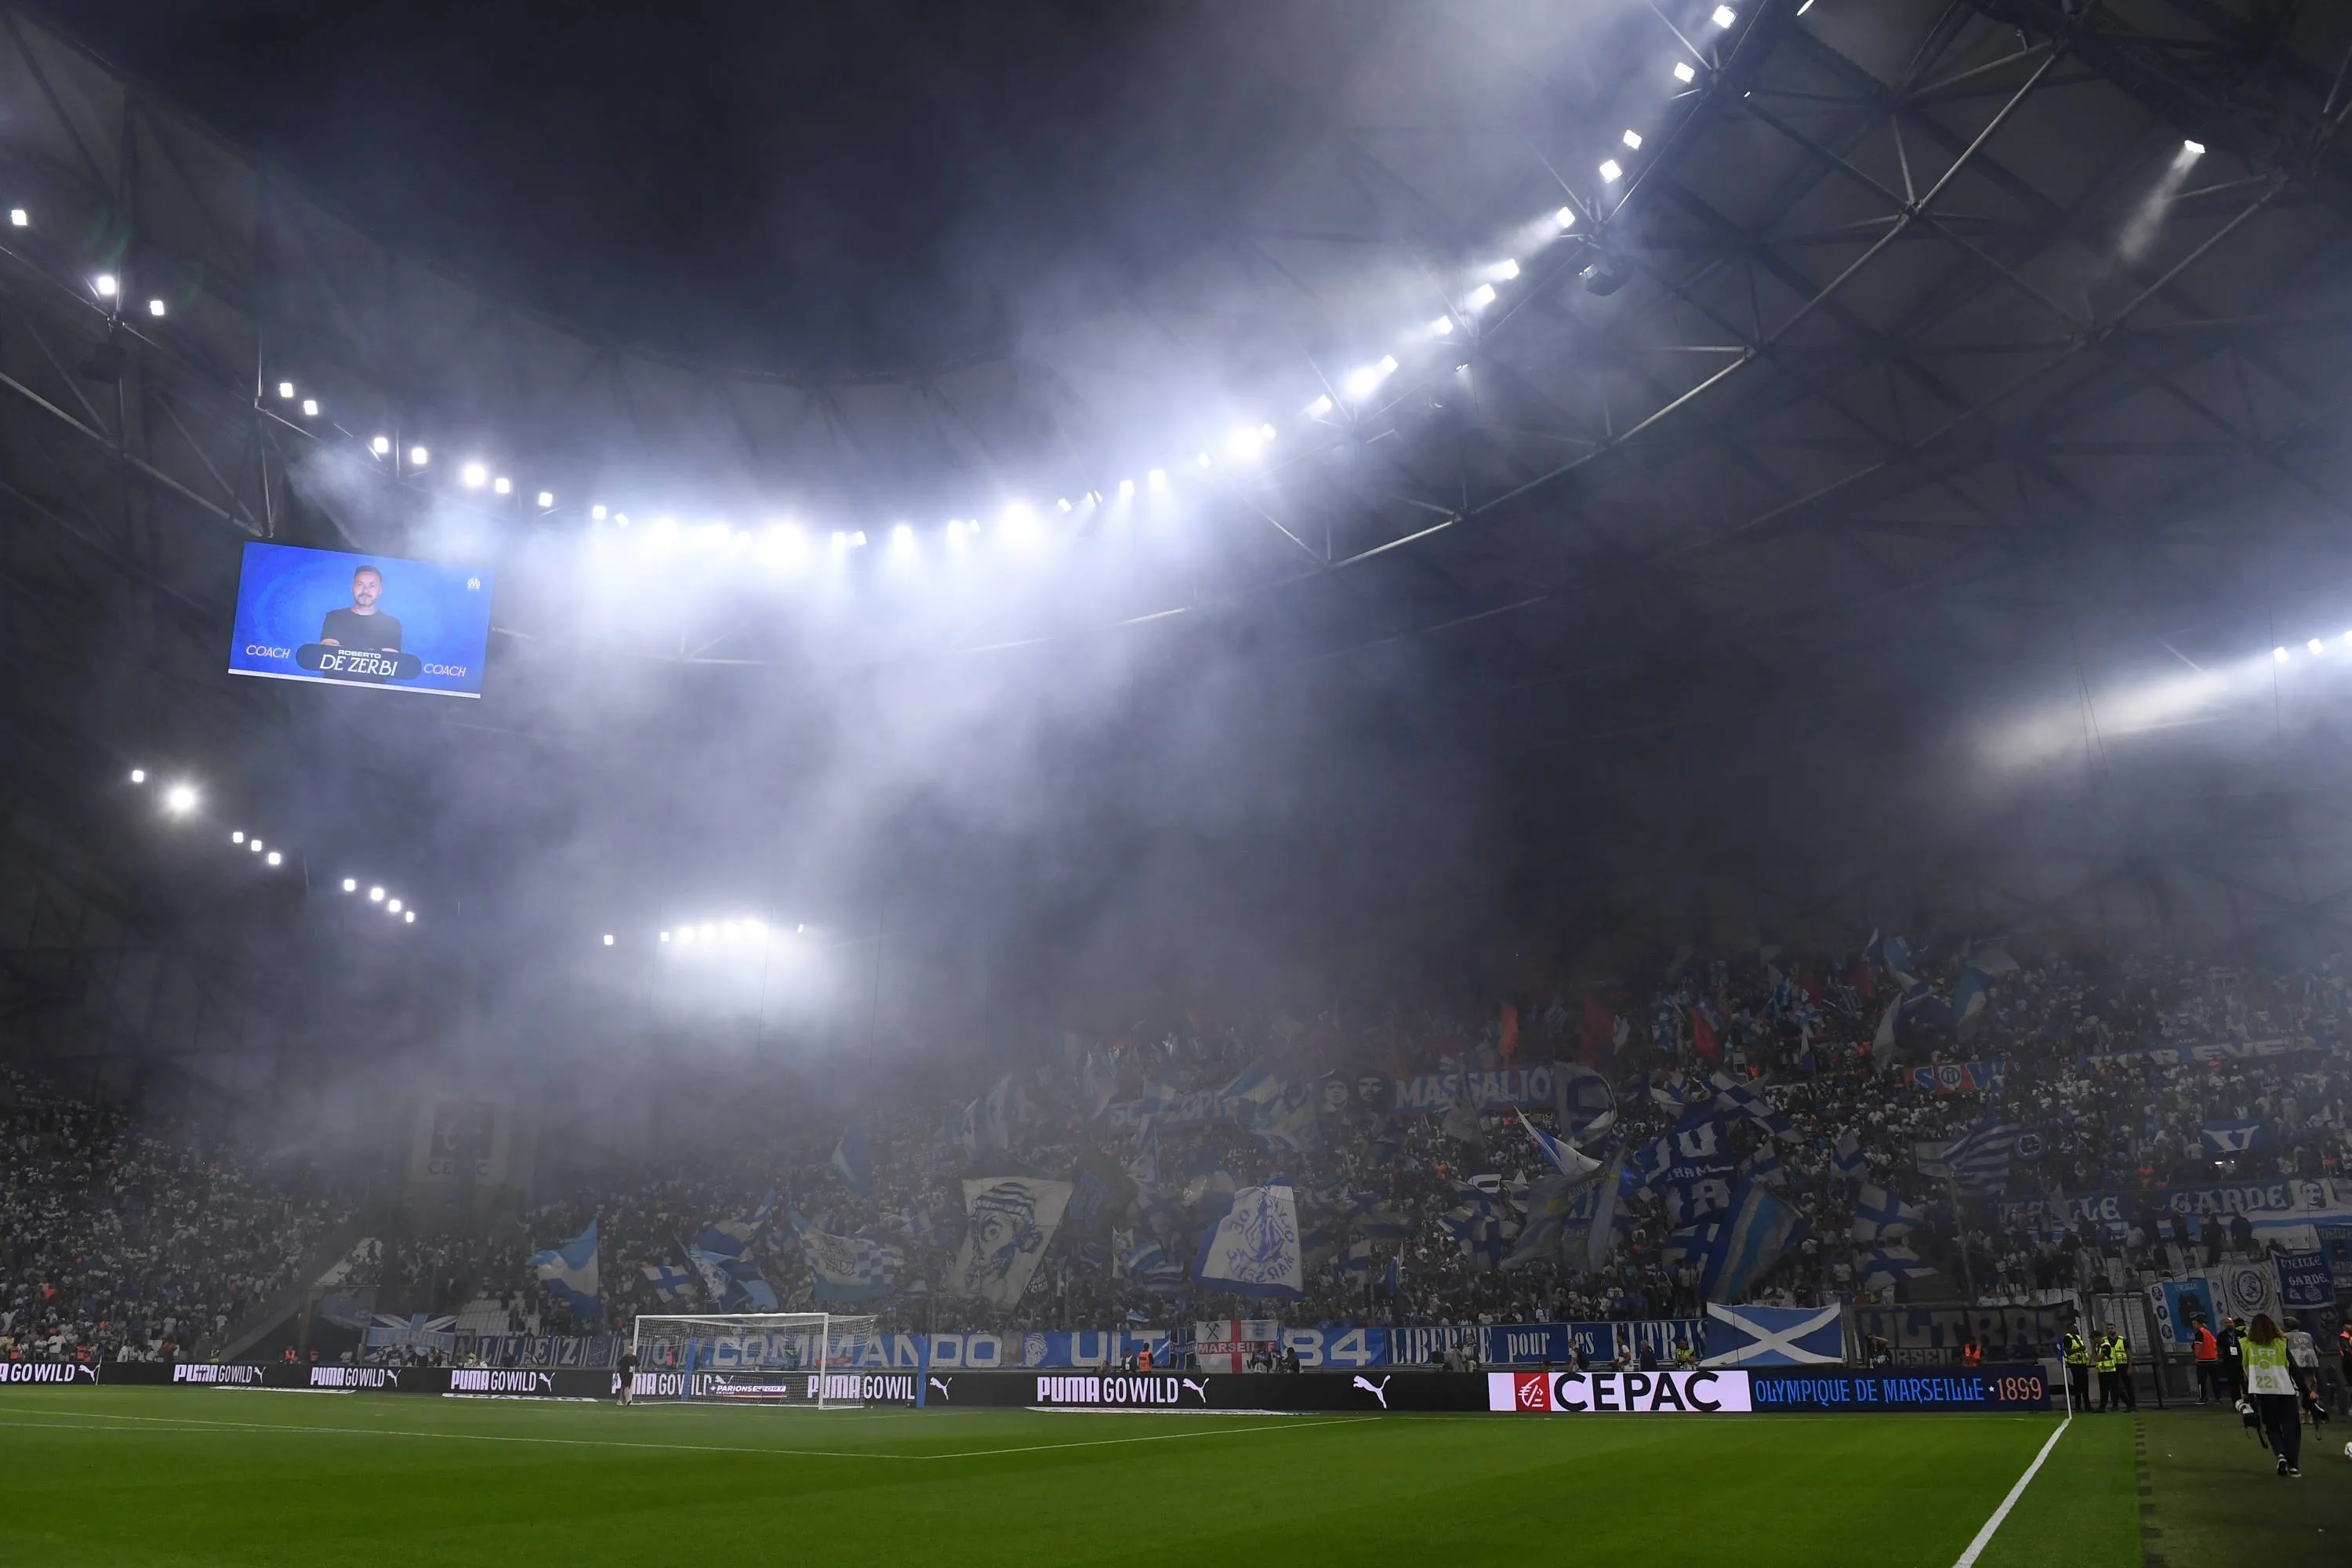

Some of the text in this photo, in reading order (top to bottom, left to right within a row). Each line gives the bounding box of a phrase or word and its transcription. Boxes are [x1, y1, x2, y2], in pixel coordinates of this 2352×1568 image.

[246, 644, 291, 659] COACH
[338, 649, 382, 659] ROBERTO
[320, 655, 398, 677] DE ZERBI
[424, 663, 466, 677] COACH
[427, 1160, 489, 1177] CEC
[2169, 1185, 2289, 1215] GARDE
[1198, 1341, 1276, 1354] MARSEILE
[1283, 1328, 1371, 1367] 84
[1507, 1331, 1550, 1363] pour
[1566, 1323, 1595, 1356] les
[2251, 1348, 2276, 1357] LFP
[173, 1364, 217, 1382] PUMA
[310, 1367, 344, 1387] PUMA
[451, 1370, 489, 1390] PUMA
[612, 1373, 656, 1395] PMA
[1037, 1377, 1099, 1402] PUMA
[1553, 1371, 1722, 1412] CEPAC
[1755, 1377, 2042, 1406] OLYMPIQUE DE MARSEILLE 1899
